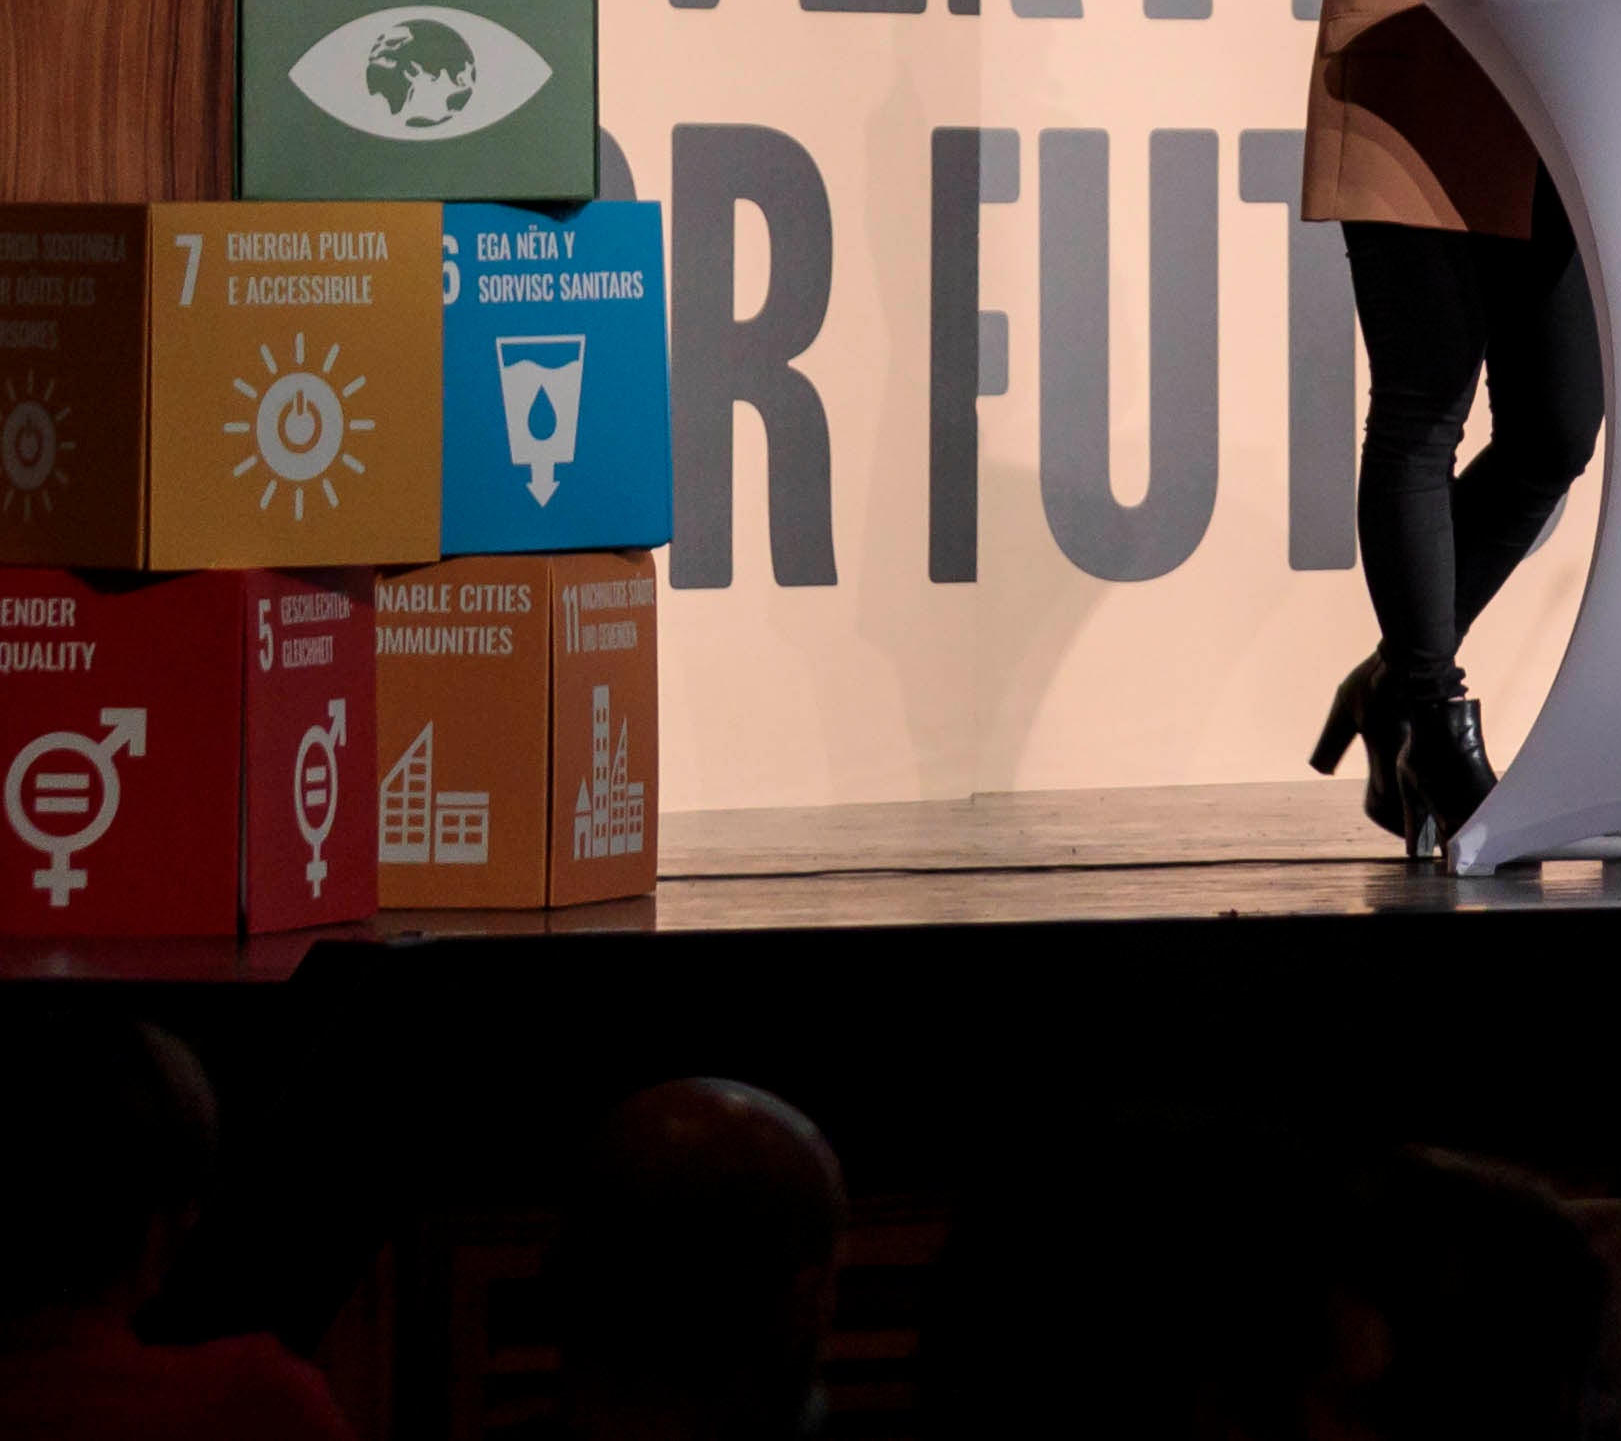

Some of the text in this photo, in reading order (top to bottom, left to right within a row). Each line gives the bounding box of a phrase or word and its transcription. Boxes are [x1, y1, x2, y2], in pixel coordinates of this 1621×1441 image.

[227, 231, 388, 262] ENERGIA PULITA
[477, 225, 576, 261] EGA NËTA Y
[175, 235, 203, 305] 7
[228, 275, 373, 305] E ACCESSIBILE
[478, 271, 644, 303] SORVISC SANITARS
[0, 598, 76, 627] ENDER
[375, 584, 531, 614] NABLE CITIES
[258, 598, 274, 671] 5
[562, 585, 579, 654] 11
[376, 626, 513, 655] MMUNITIES
[0, 641, 96, 673] QUALITY
